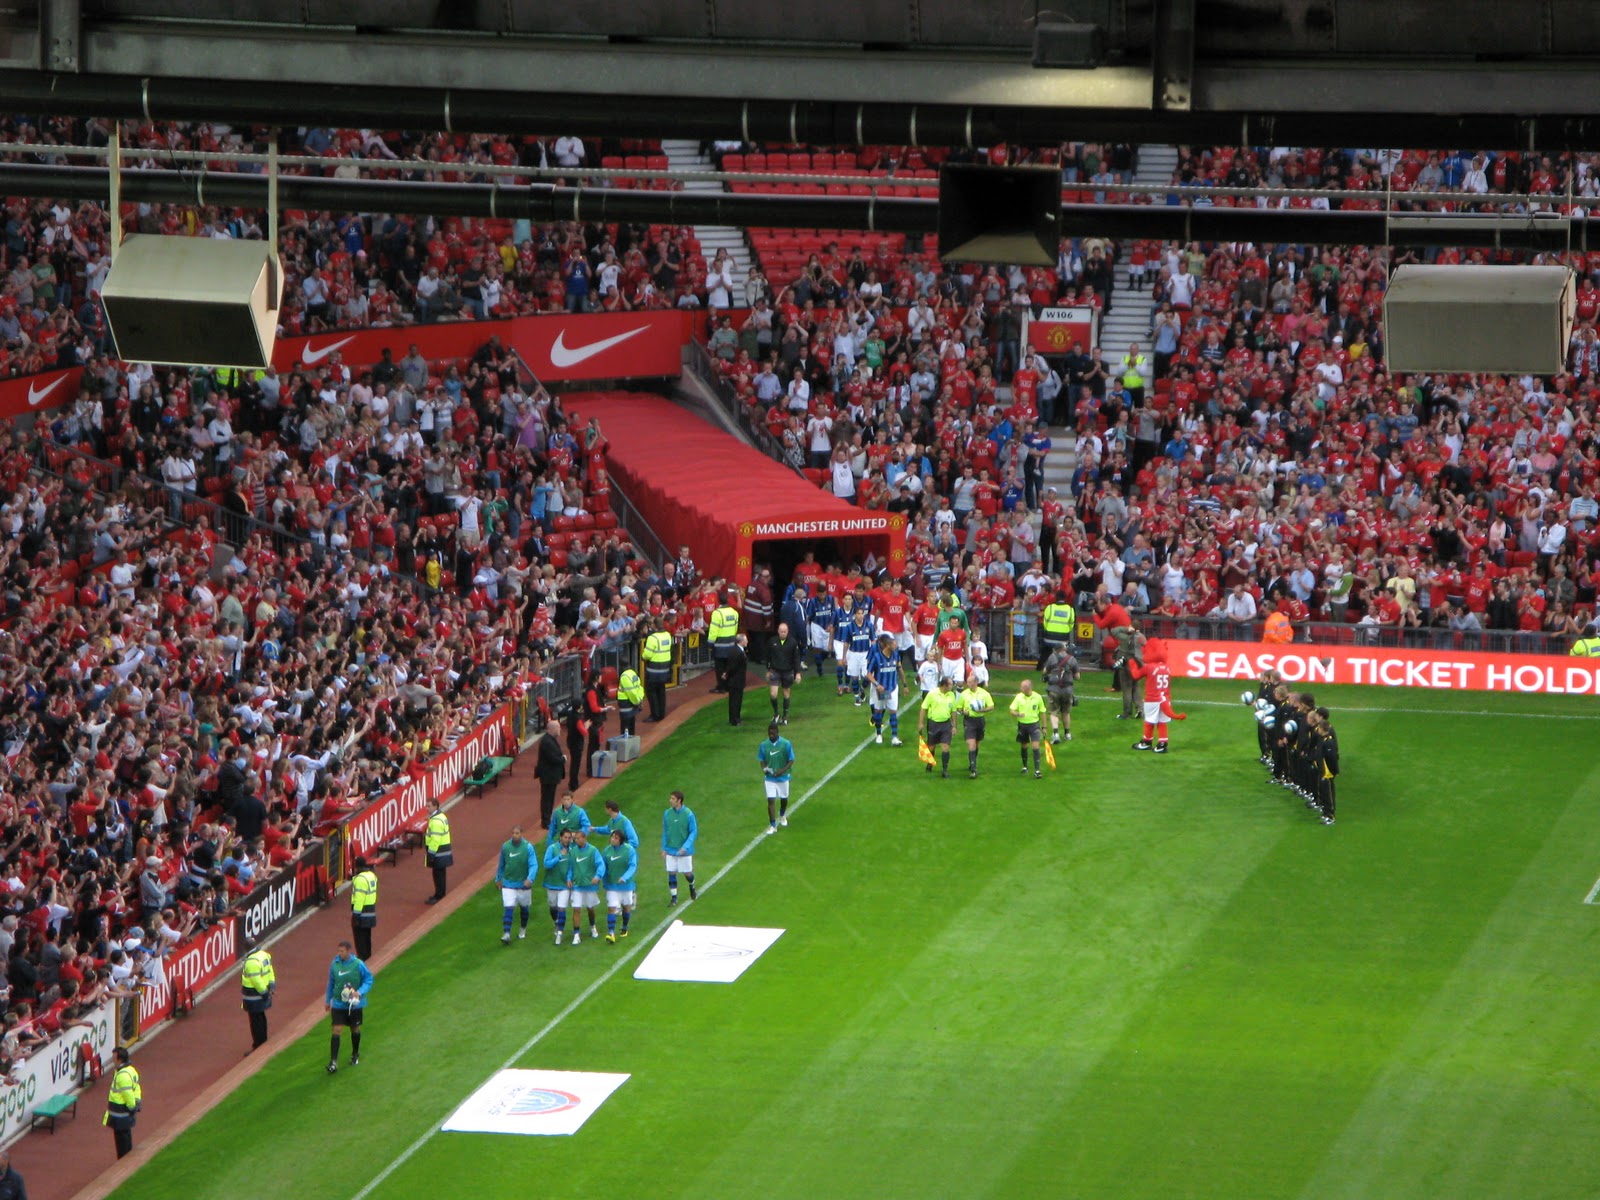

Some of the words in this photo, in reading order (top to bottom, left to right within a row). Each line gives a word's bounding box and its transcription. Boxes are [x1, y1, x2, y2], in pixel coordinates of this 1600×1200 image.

[756, 520, 839, 535] MANCHESTER
[841, 518, 887, 530] UNITED
[1082, 628, 1090, 637] 6
[691, 637, 697, 646] 7
[1186, 651, 1335, 682] SEASON
[1347, 657, 1475, 688] TICKET
[1156, 674, 1169, 689] 55
